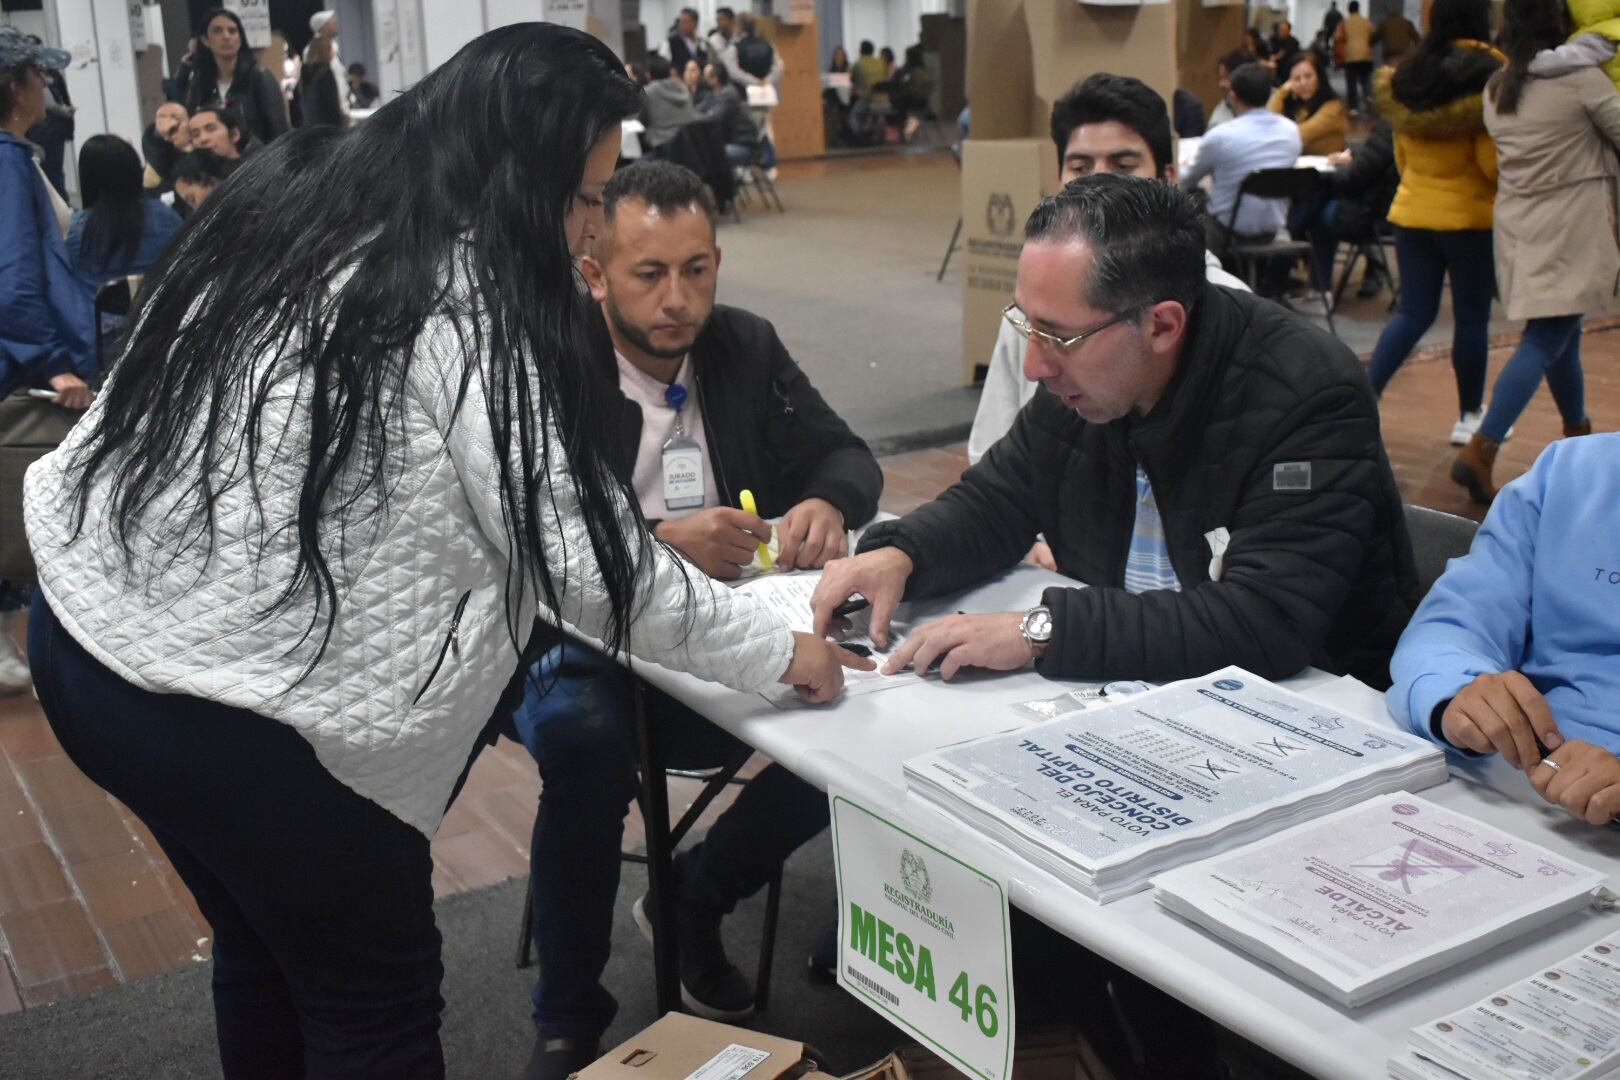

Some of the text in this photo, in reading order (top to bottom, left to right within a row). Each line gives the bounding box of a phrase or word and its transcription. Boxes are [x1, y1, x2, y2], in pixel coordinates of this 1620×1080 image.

[1016, 739, 1095, 779] CAPITAL
[1031, 763, 1074, 783] DEL
[1051, 787, 1075, 797] EL
[1071, 797, 1112, 816] PARA
[1074, 783, 1167, 831] CONCEJO
[1095, 778, 1189, 826] DISTRITO
[1109, 815, 1152, 836] VOTO
[883, 883, 954, 933] REGISTRADURÍA
[1315, 885, 1411, 933] ALCALDE
[1330, 904, 1362, 920] PARA
[1362, 920, 1396, 937] VOTO
[850, 902, 936, 1002] MESA
[949, 970, 999, 1038] 46
